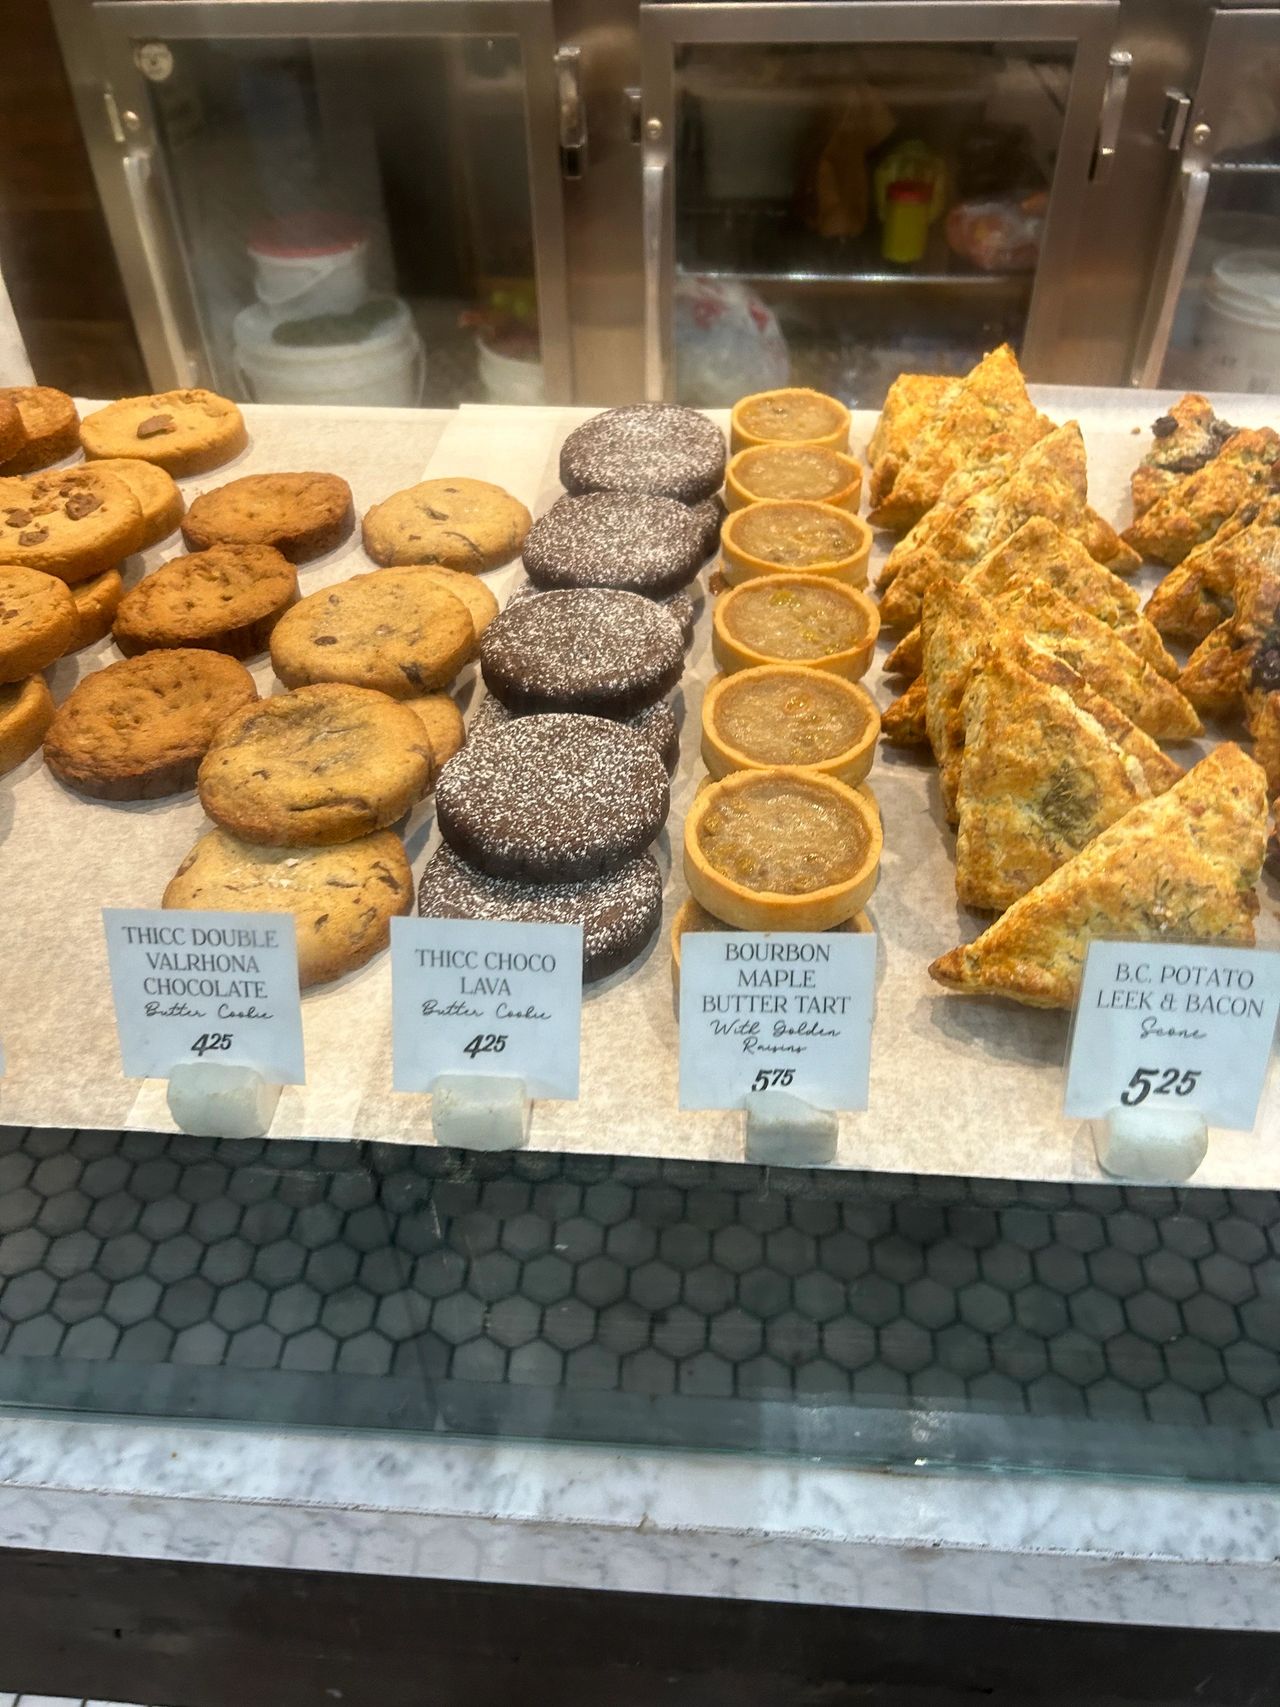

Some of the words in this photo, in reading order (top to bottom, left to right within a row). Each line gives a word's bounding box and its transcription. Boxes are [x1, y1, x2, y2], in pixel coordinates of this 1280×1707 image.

[121, 926, 185, 946] THICC
[192, 928, 279, 948] DOUBLE
[145, 952, 260, 973] VALRHONA
[414, 948, 479, 970] THICC
[484, 951, 556, 973] CHOCO
[725, 943, 831, 963] BOURBON
[459, 976, 511, 996] LAVA
[737, 968, 816, 989] MAPLE
[1115, 962, 1152, 984] B.C.
[1160, 965, 1254, 991] POTATO
[143, 977, 268, 999] CHOCOLATE
[144, 1001, 207, 1018] Butter
[217, 1003, 274, 1020] Cookie
[421, 999, 484, 1017] Butter
[495, 1002, 552, 1020] Cookie
[702, 994, 788, 1014] BUTTER
[794, 995, 851, 1015] TART
[1096, 989, 1154, 1011] LEEK
[1160, 993, 1177, 1012] &
[1185, 994, 1265, 1019] BACON
[709, 1018, 761, 1036] With
[772, 1019, 840, 1038] Golden
[1139, 1016, 1208, 1040] Scone
[742, 1036, 807, 1055] Raisins
